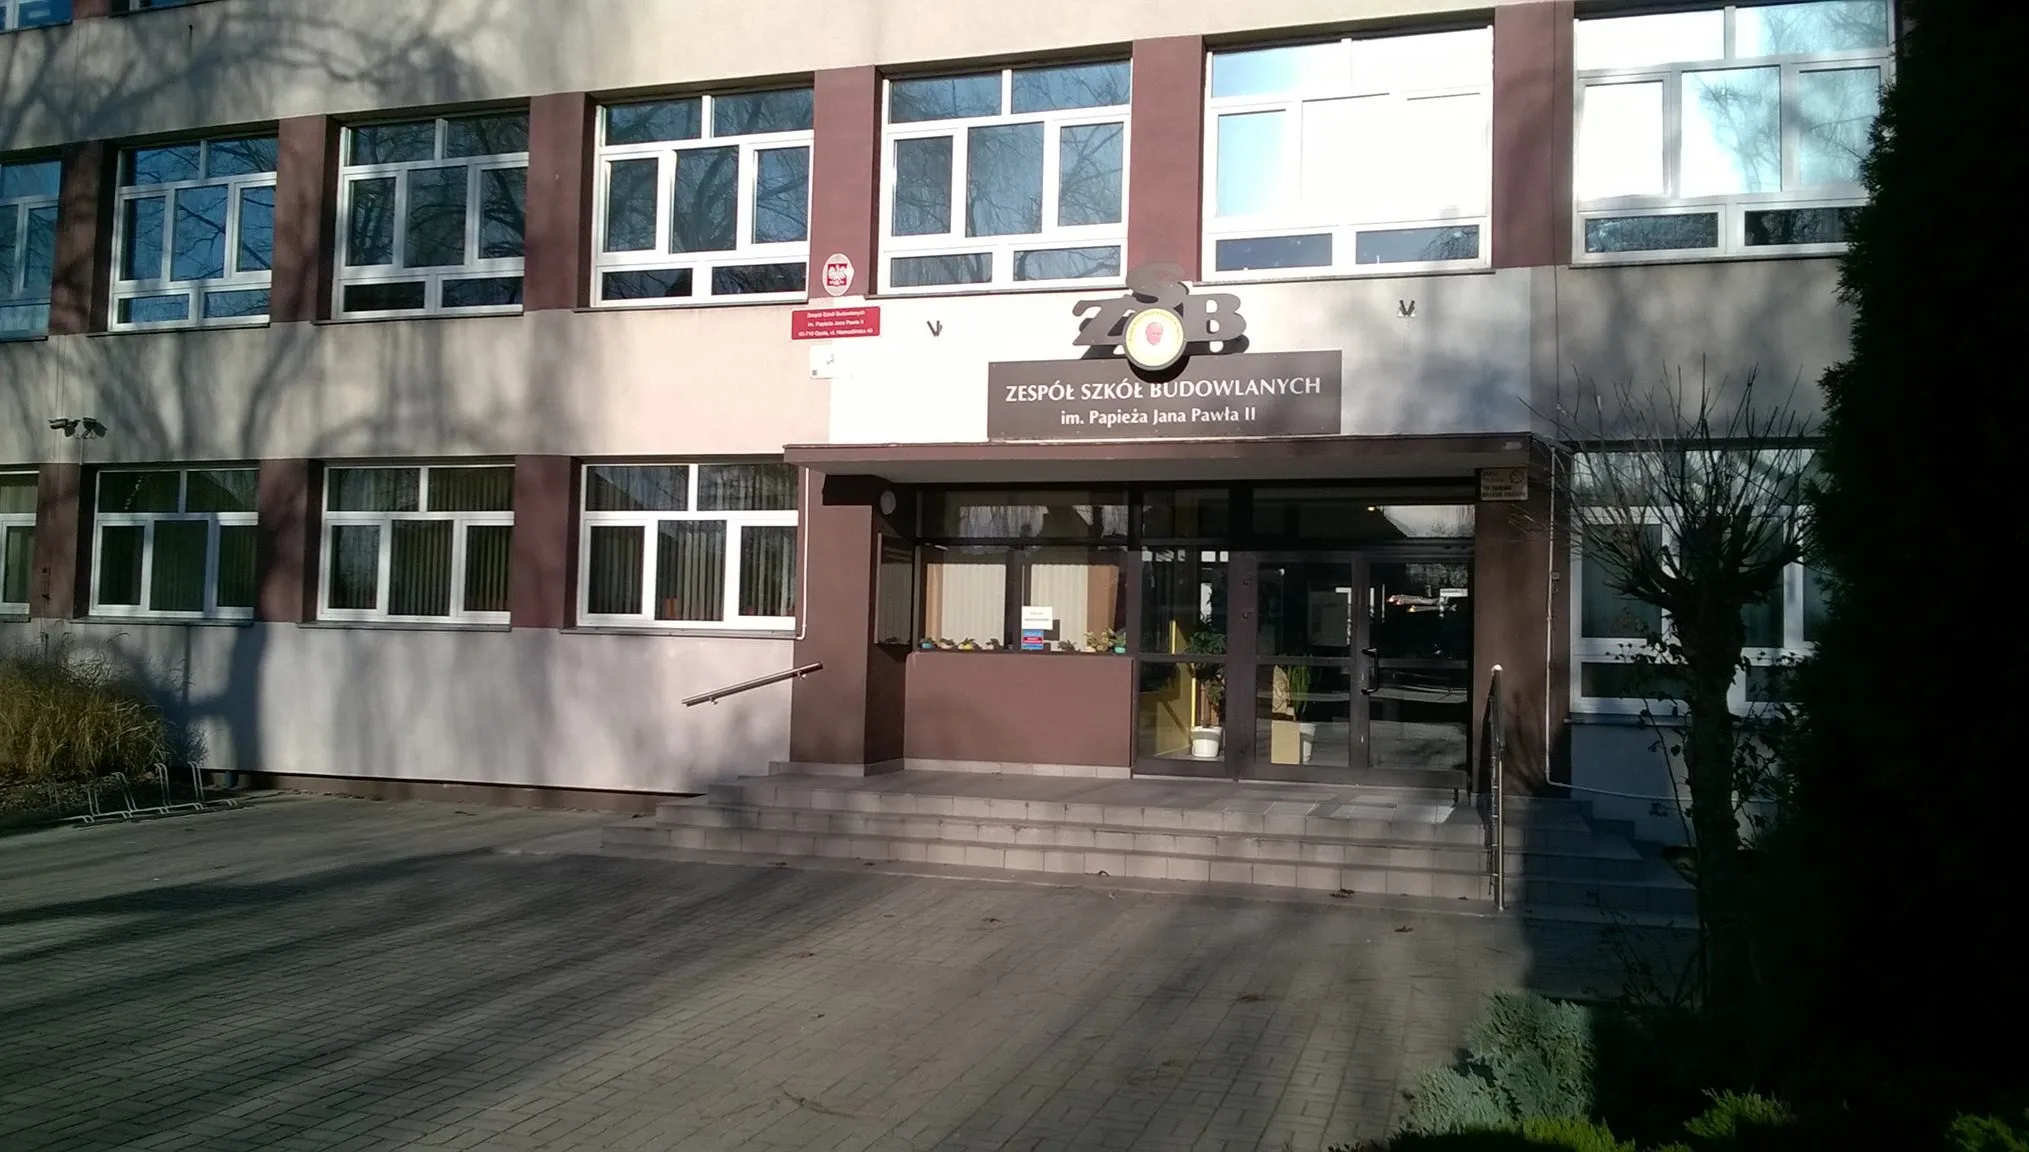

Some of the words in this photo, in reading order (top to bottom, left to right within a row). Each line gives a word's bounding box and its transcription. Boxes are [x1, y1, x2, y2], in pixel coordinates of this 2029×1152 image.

[1005, 379, 1076, 402] ZESPÓŁ
[1081, 377, 1144, 401] SZKÓŁ
[1149, 377, 1321, 399] BUDOWLANYCH
[1060, 410, 1084, 425] im.
[1089, 408, 1148, 428] Papieża
[1152, 408, 1187, 426] Jana
[1191, 406, 1240, 423] Pawła
[1244, 406, 1256, 422] II
